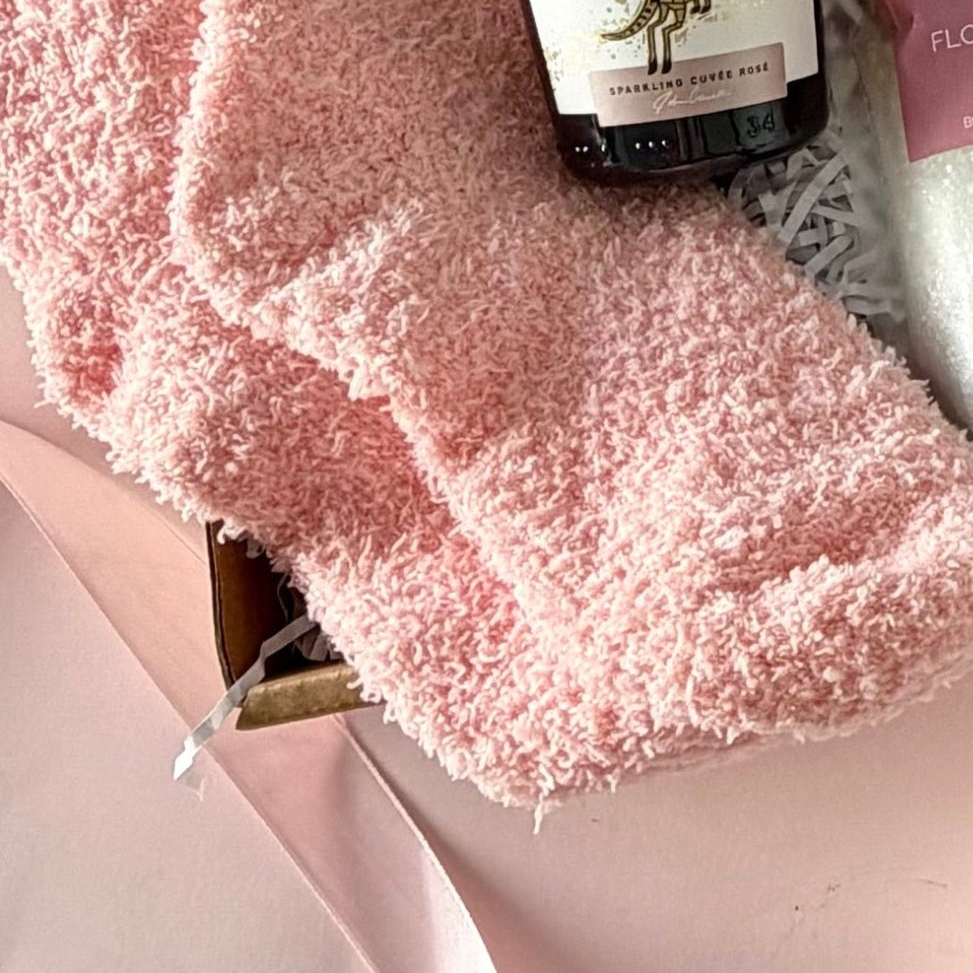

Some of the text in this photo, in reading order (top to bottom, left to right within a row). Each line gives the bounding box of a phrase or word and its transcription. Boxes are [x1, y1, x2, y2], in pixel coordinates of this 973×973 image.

[609, 61, 770, 96] SPARKLING CUVÉE ROSÉ
